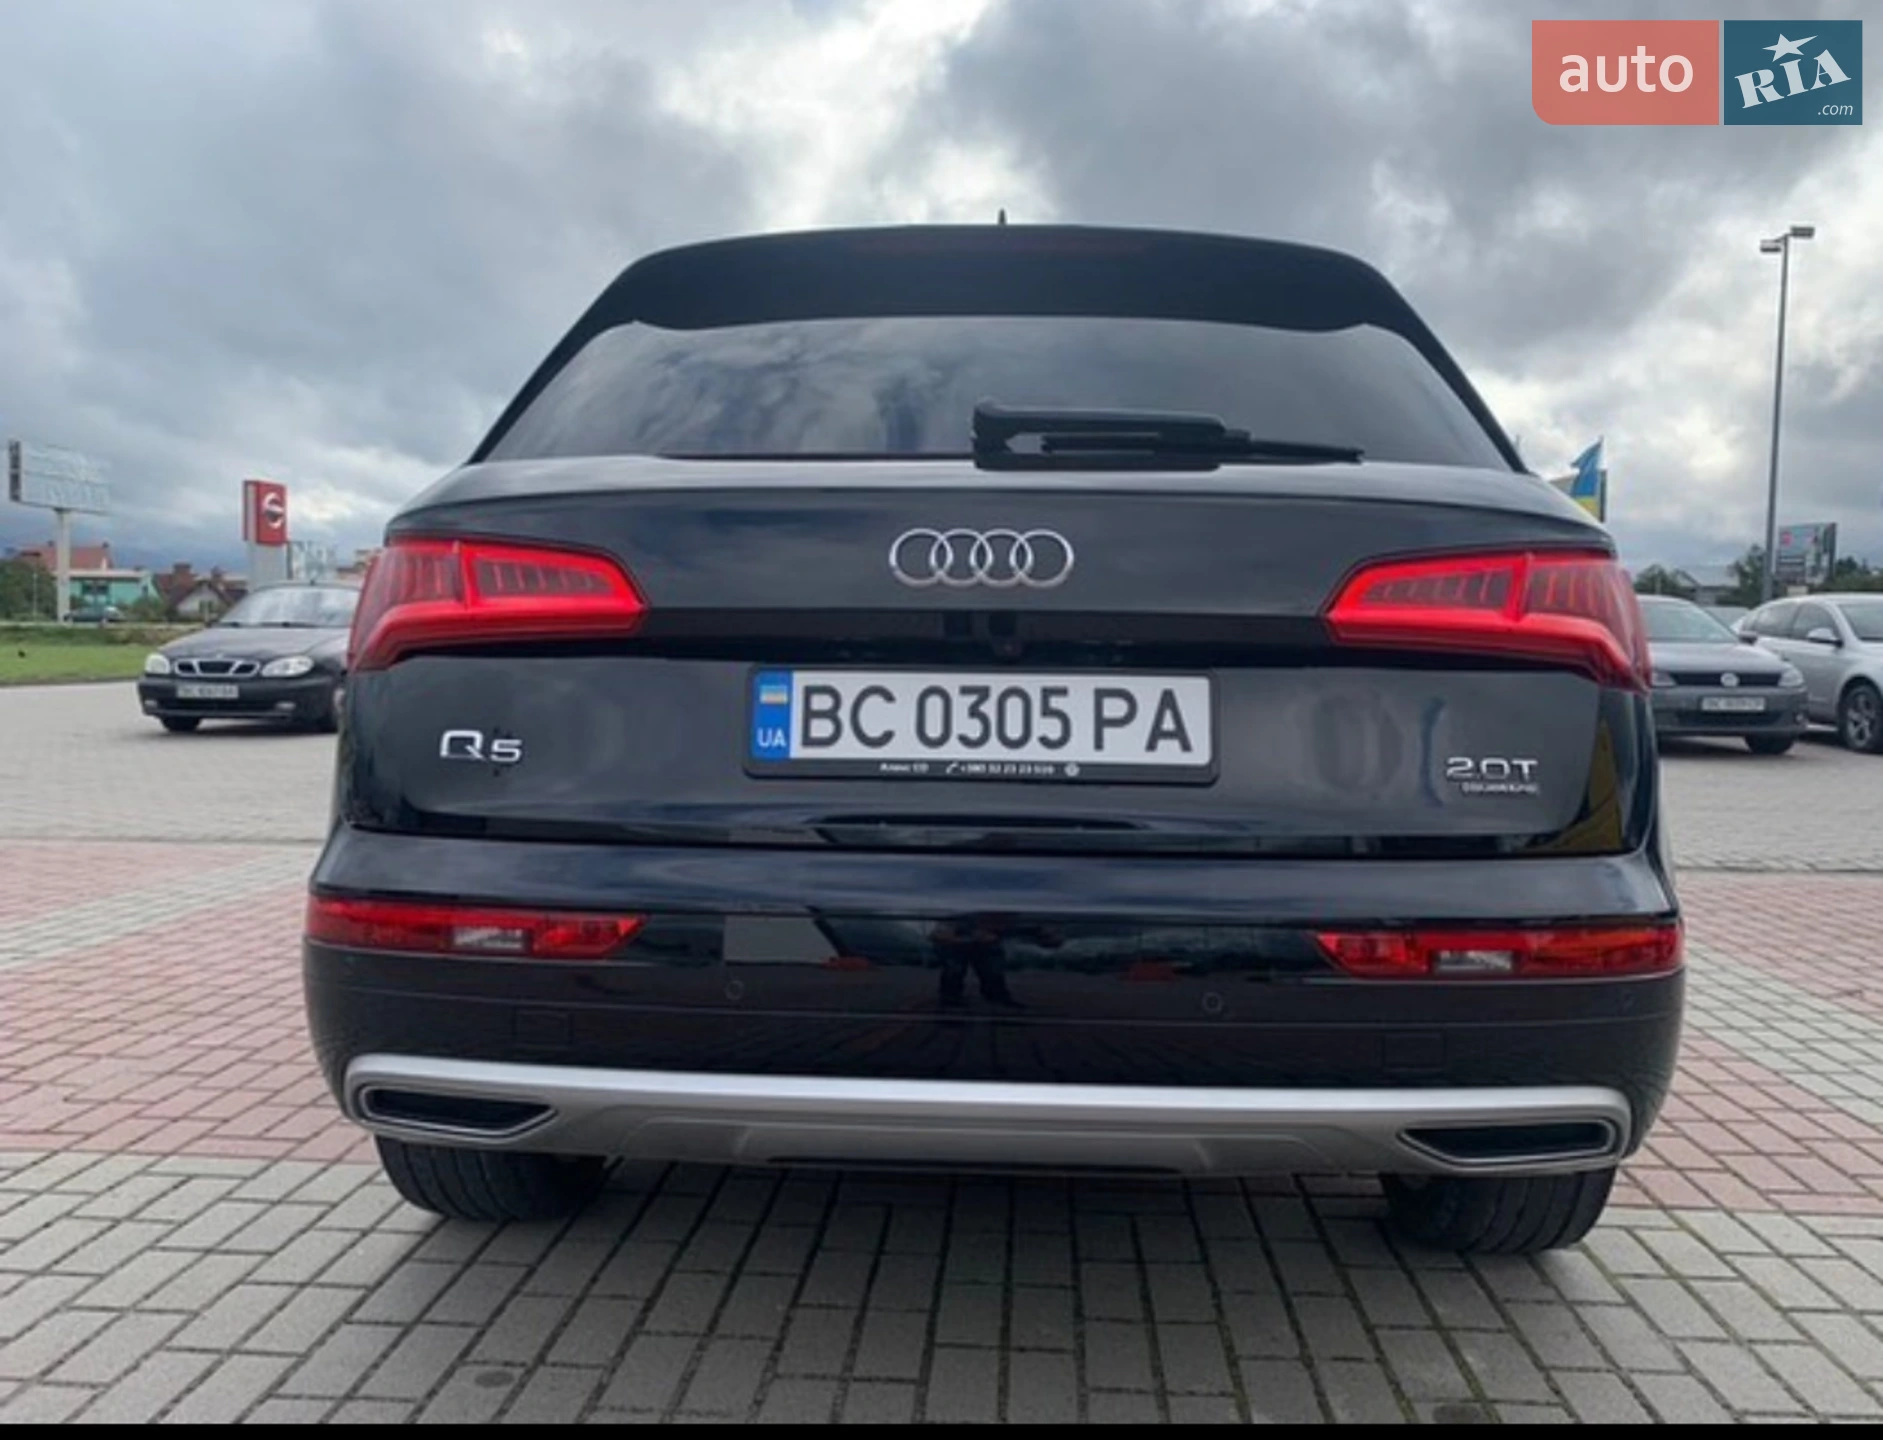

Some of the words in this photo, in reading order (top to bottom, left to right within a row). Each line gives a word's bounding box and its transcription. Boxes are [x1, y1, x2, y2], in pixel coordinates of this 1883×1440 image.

[801, 684, 897, 749] BC
[915, 685, 1072, 750] 0305
[1092, 687, 1194, 753] PA
[439, 729, 522, 762] Q5
[757, 728, 787, 748] UA
